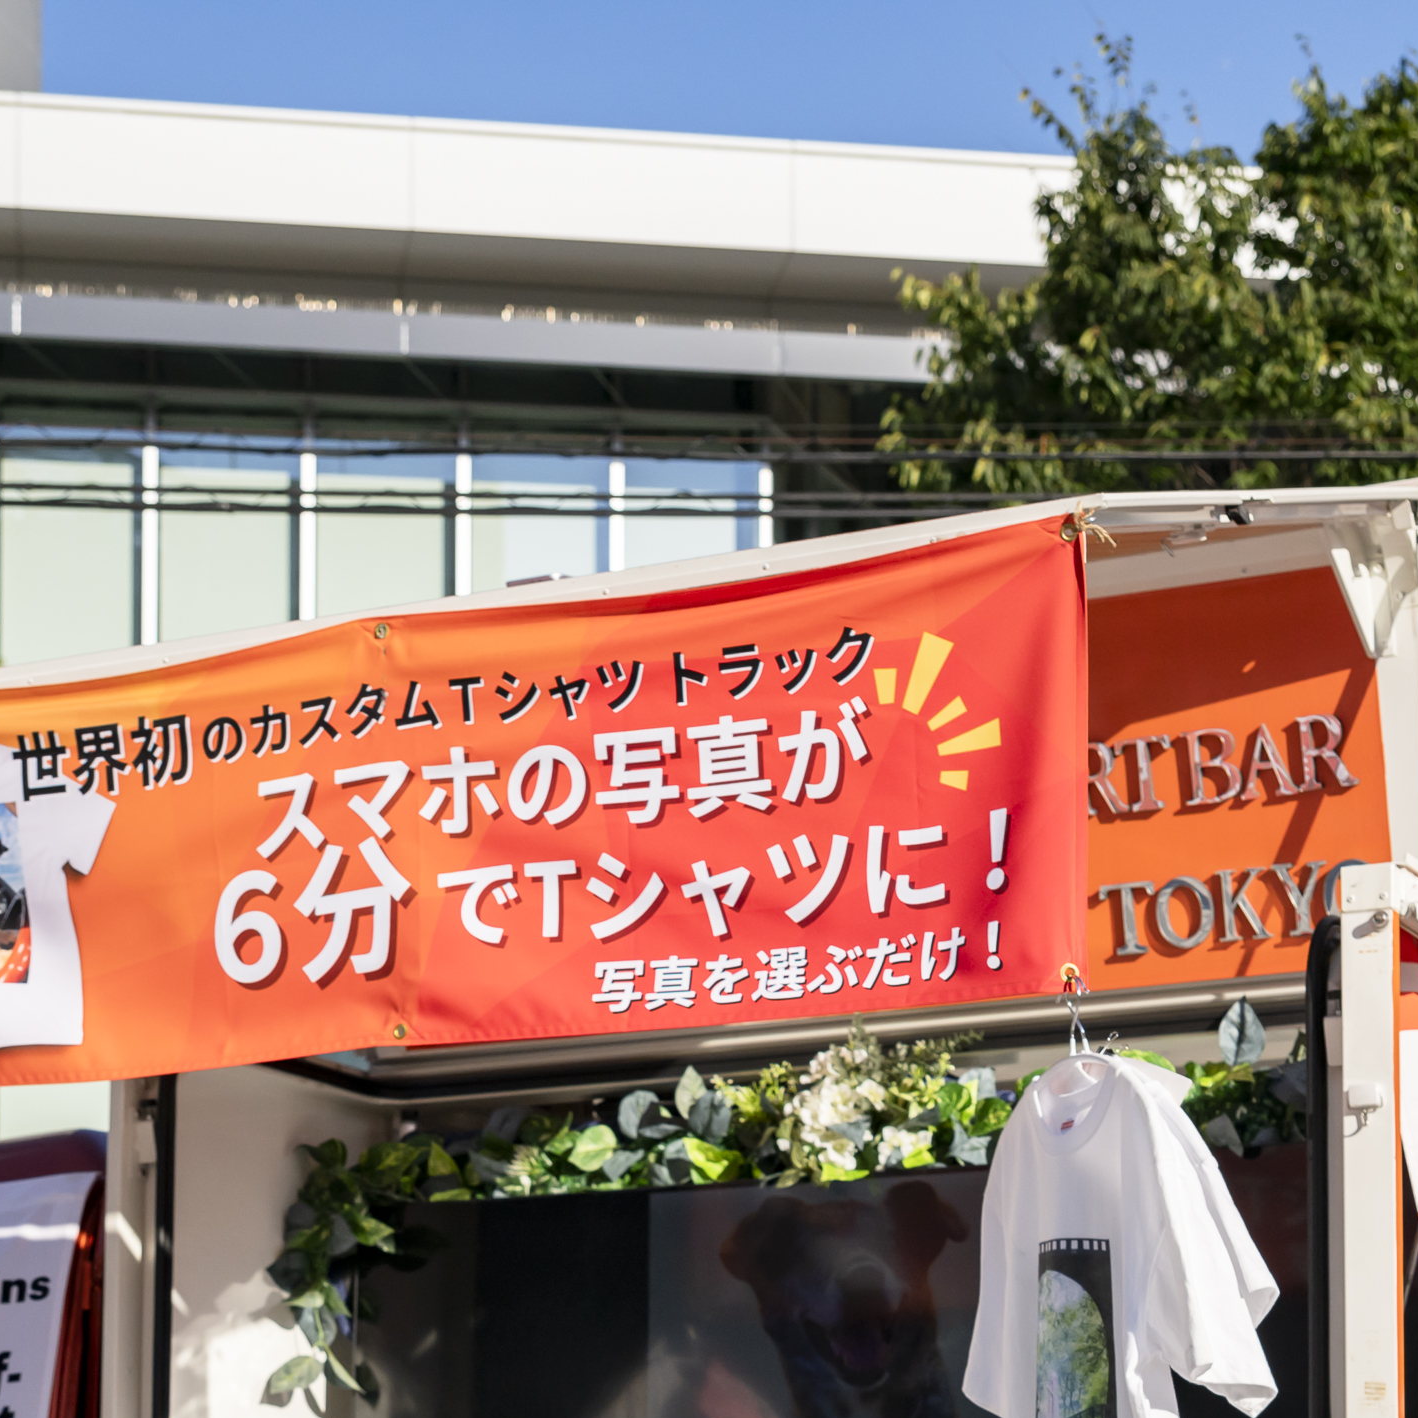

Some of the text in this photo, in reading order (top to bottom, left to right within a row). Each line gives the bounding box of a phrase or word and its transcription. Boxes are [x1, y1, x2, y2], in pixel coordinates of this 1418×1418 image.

[256, 696, 873, 862] スマホの写真が
[1179, 713, 1360, 806] BAR
[214, 807, 1011, 988] 6分でTシャツに！
[591, 919, 1003, 1016] 写真を選ぶだけ！
